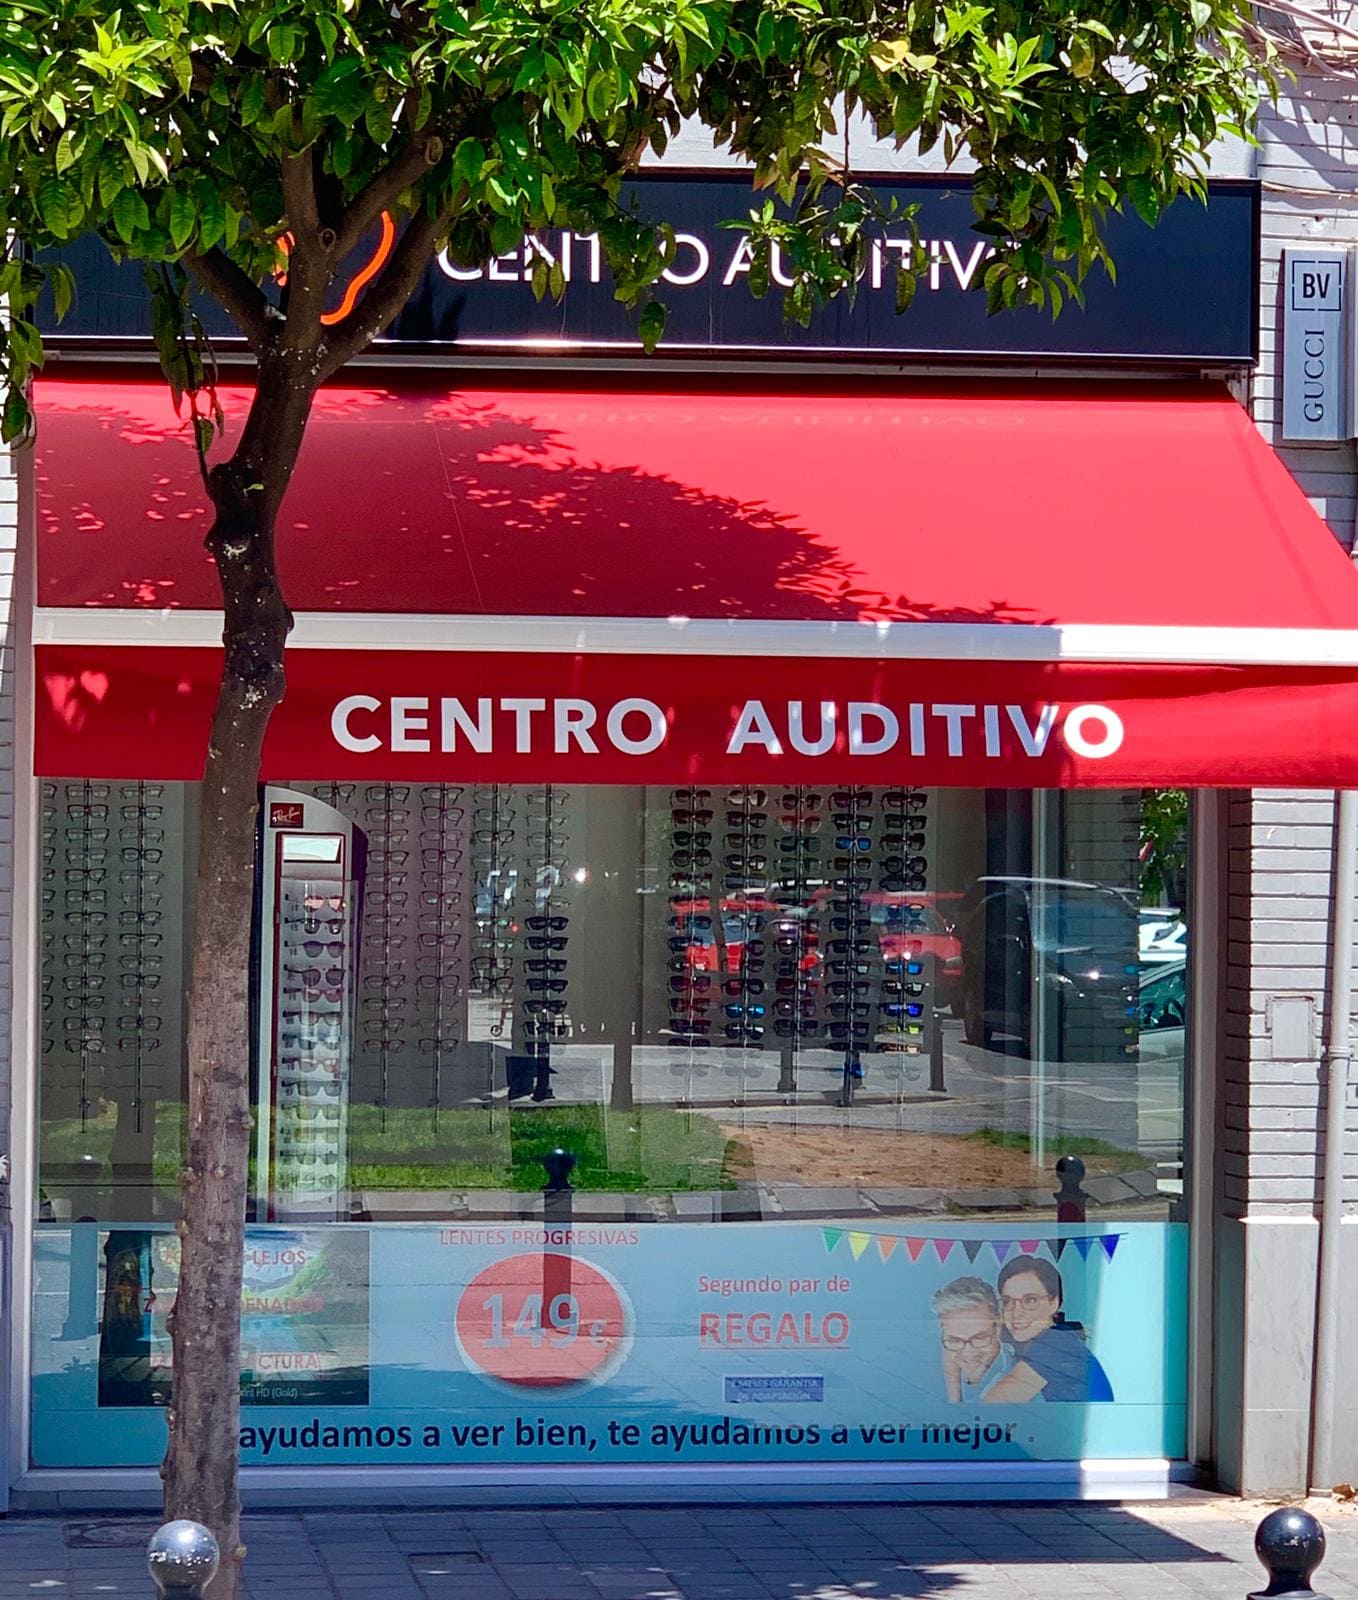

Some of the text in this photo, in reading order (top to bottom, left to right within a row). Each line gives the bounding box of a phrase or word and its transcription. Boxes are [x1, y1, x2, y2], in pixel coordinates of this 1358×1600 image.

[438, 231, 1029, 291] CENTO AUITIV
[1303, 273, 1330, 299] BV
[1304, 330, 1325, 422] GUCCI
[331, 694, 1124, 758] CENTRO AUDITIVO
[440, 1230, 639, 1245] LENTES PROGRESIVAS
[252, 1250, 306, 1265] LEJOS
[699, 1275, 850, 1296] Segundo par de
[700, 1312, 850, 1345] REGALO
[239, 1419, 412, 1455] ayudamos
[423, 1426, 441, 1448] a
[451, 1426, 504, 1447] ver
[516, 1418, 597, 1452] bien,
[608, 1420, 640, 1446] te
[651, 1417, 821, 1452] ayudamos
[831, 1423, 849, 1446] a
[859, 1423, 911, 1445] ver
[921, 1416, 1018, 1450] mejor
